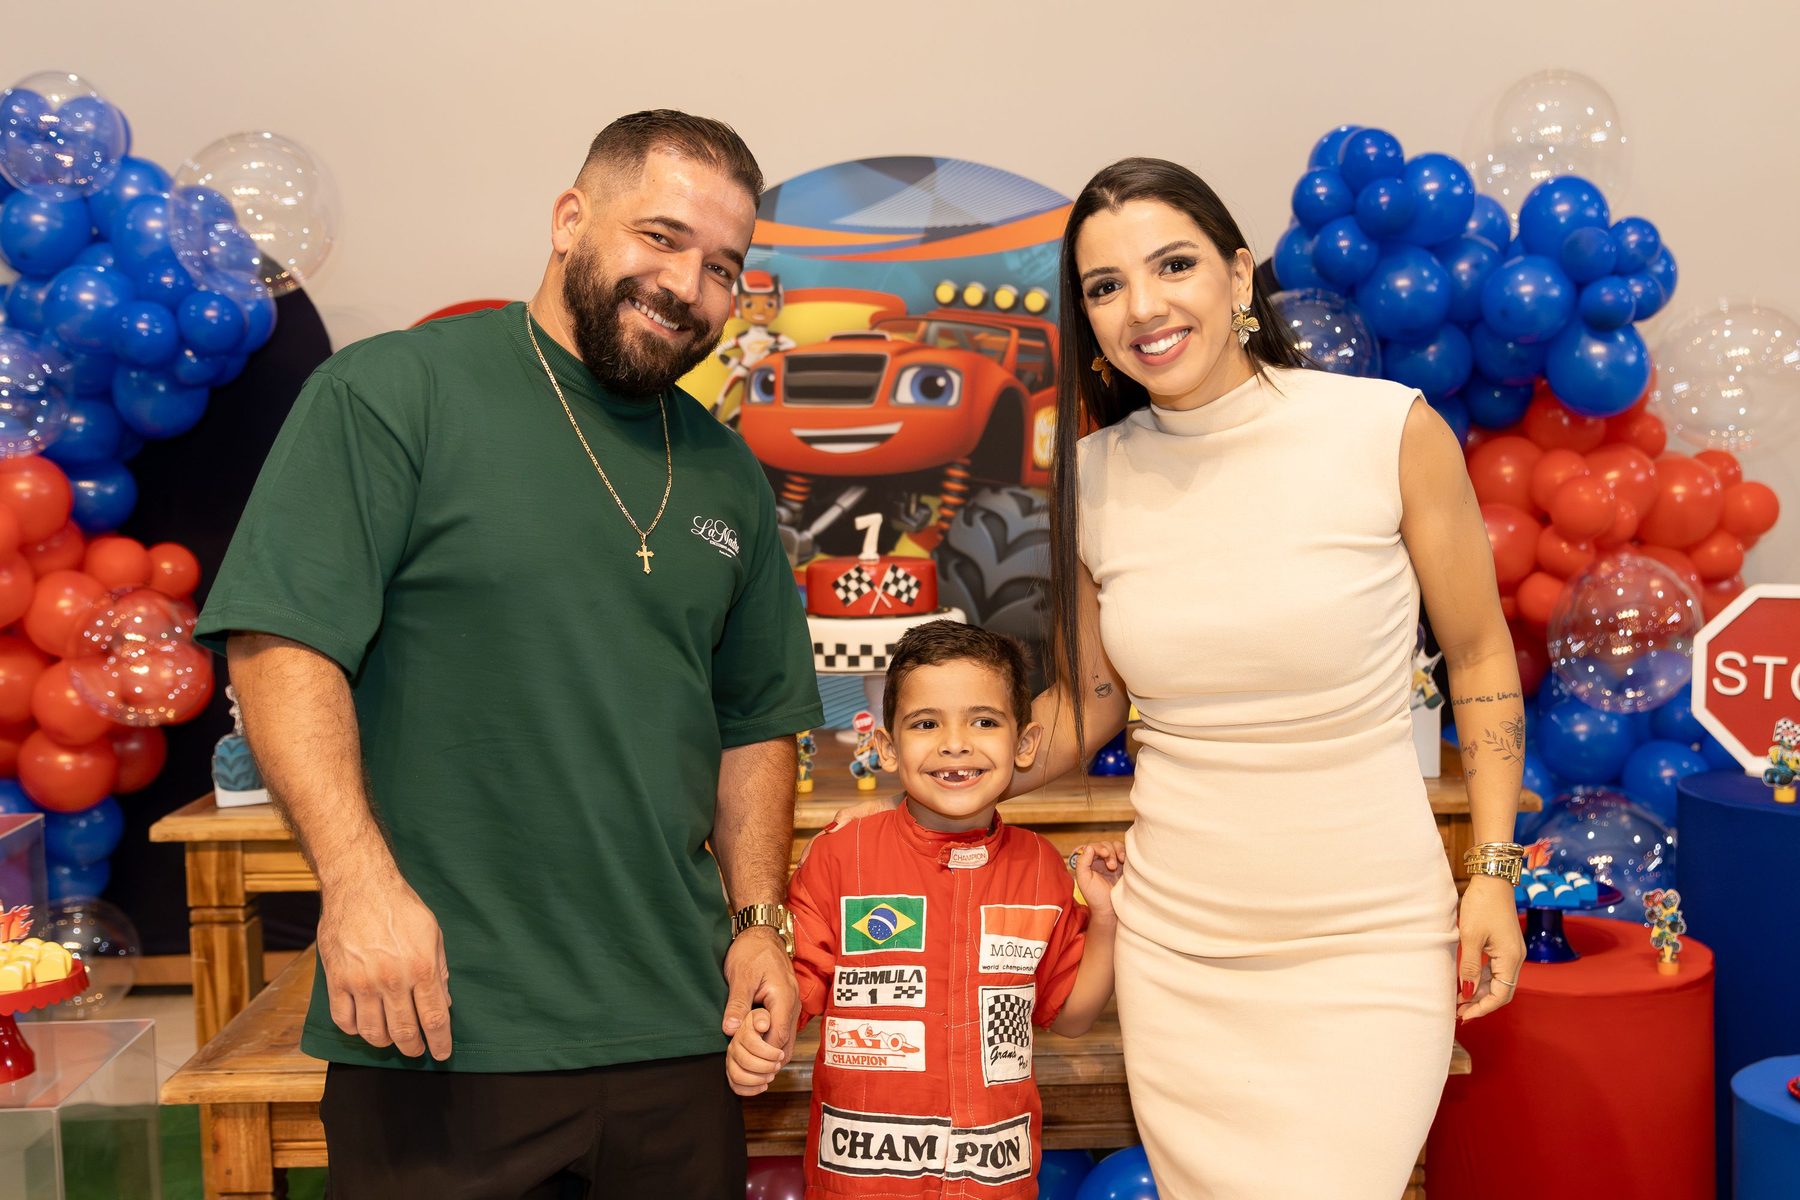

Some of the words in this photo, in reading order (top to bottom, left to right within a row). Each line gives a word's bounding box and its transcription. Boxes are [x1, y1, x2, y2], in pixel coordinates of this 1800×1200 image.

[1712, 651, 1800, 701] ST
[868, 988, 878, 1004] 1
[832, 1054, 887, 1066] CHAMPION
[990, 1046, 1017, 1066] Grand
